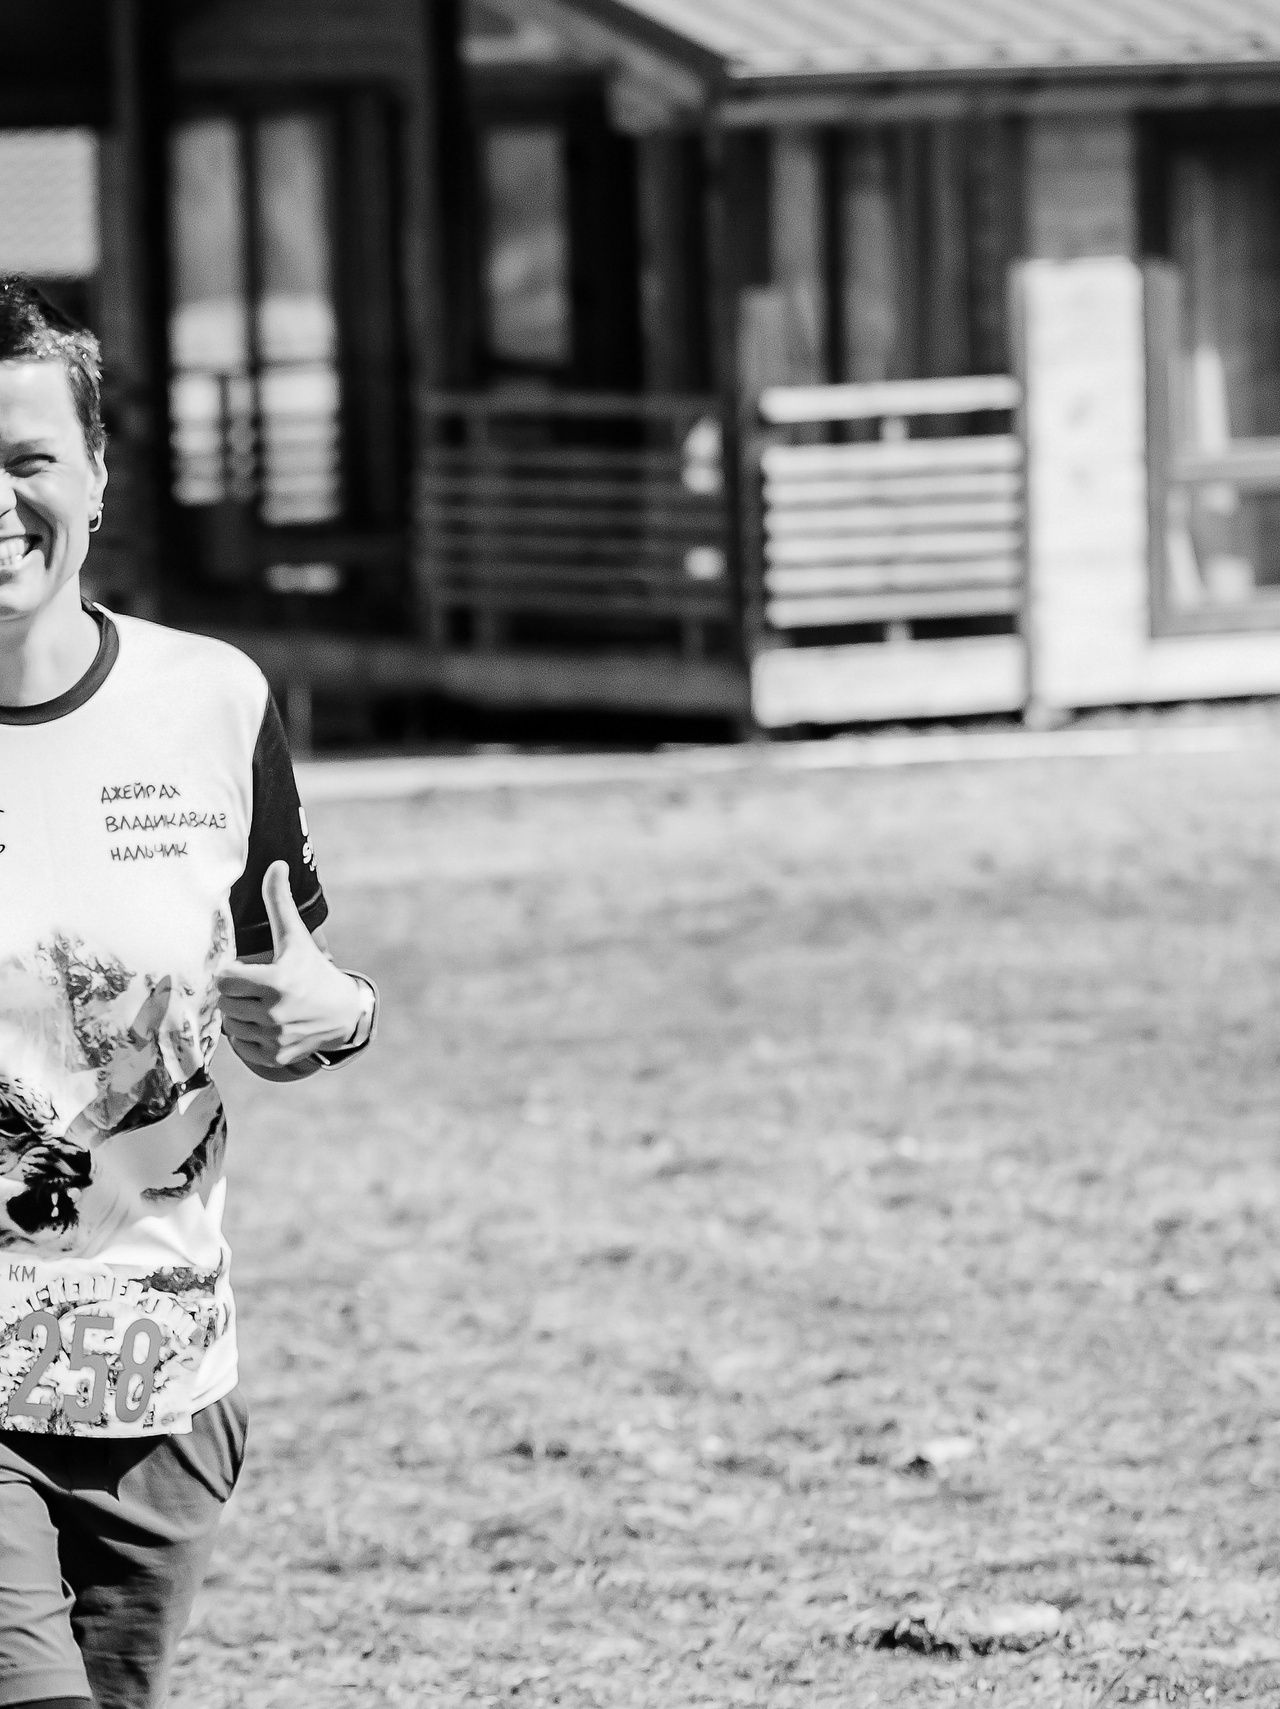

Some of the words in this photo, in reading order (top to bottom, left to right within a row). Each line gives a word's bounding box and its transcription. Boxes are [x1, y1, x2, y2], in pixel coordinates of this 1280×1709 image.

[101, 782, 181, 804] ДЖЕЙРАХ
[105, 811, 227, 833] ВЛАДИКАВКАЗ
[110, 842, 189, 862] НАЛЬЧИК
[8, 1263, 37, 1284] KM
[7, 1311, 162, 1424] 258
